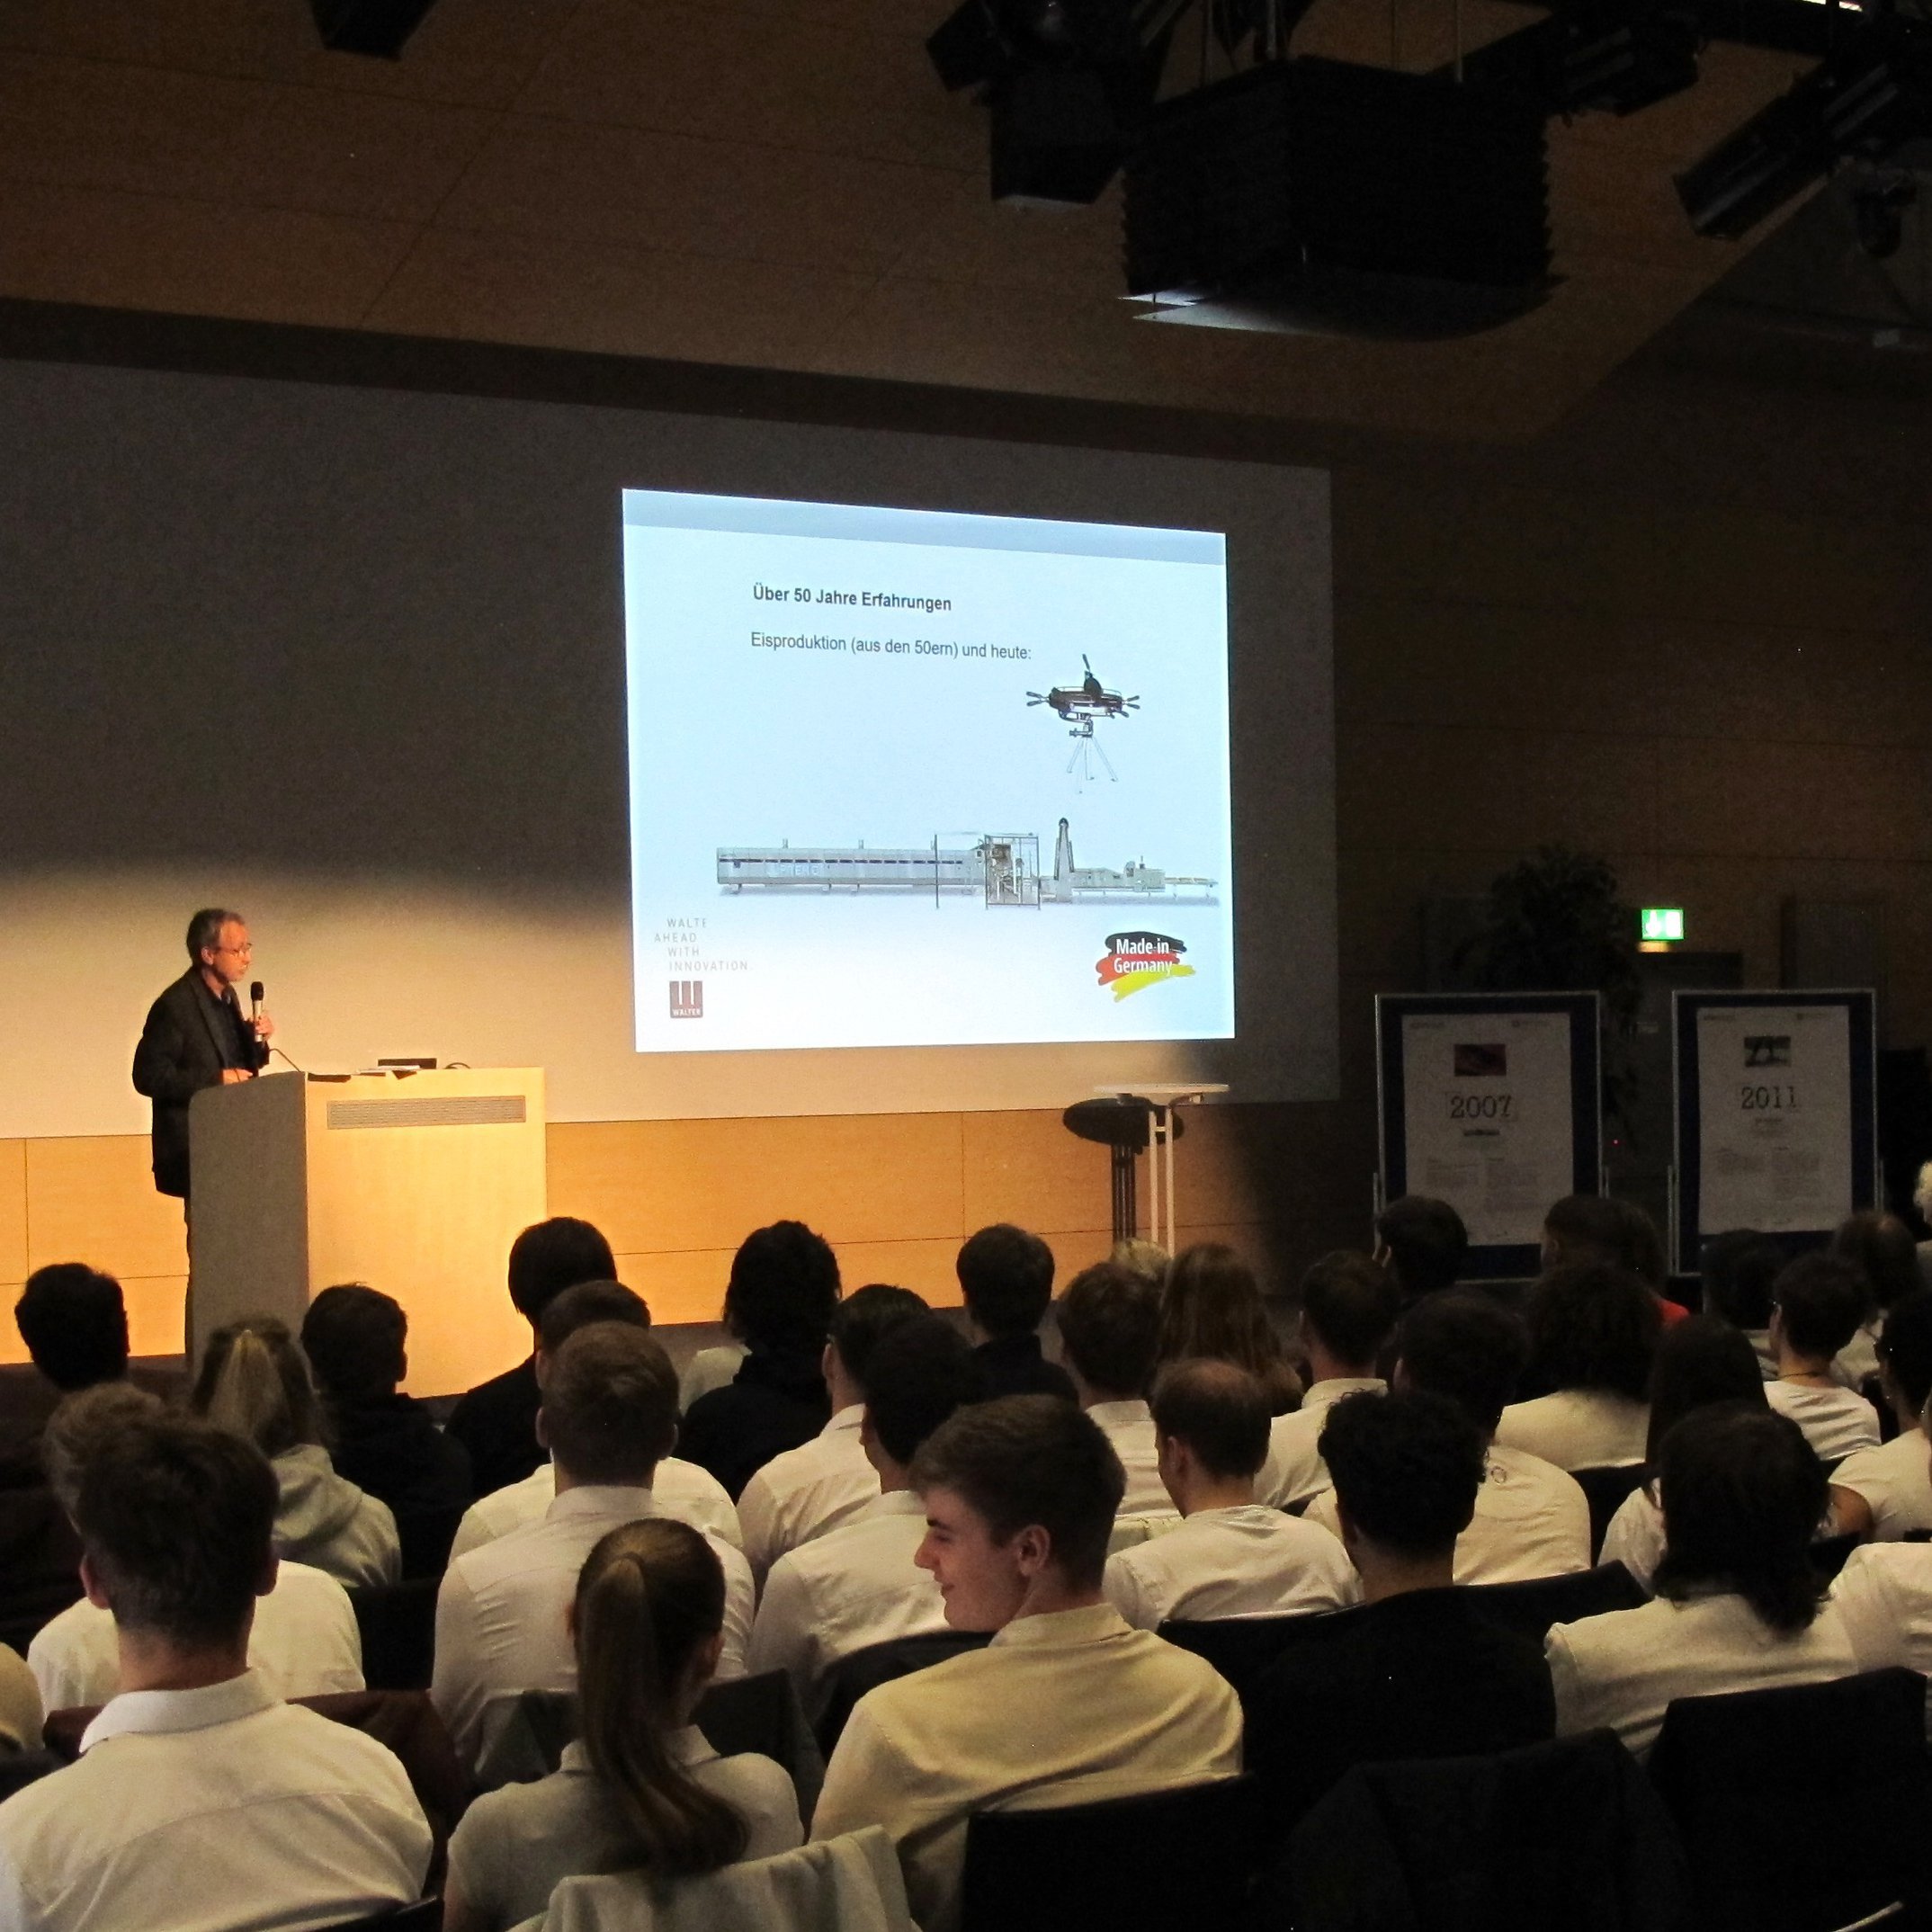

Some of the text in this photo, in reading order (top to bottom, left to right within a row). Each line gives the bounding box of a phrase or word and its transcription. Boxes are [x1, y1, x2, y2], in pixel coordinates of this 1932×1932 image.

[753, 582, 952, 613] Über 50 Jahre Erfahrungen
[751, 631, 1032, 660] Eisproduktion (aus den 50ern) und heute:
[654, 933, 697, 943] AHEAD
[1116, 938, 1170, 954] Made in
[667, 946, 700, 957] WITH
[669, 961, 748, 971] INNOVATION
[1114, 958, 1173, 977] Germany
[1450, 1095, 1512, 1119] 2007
[1741, 1086, 1797, 1110] 2011
